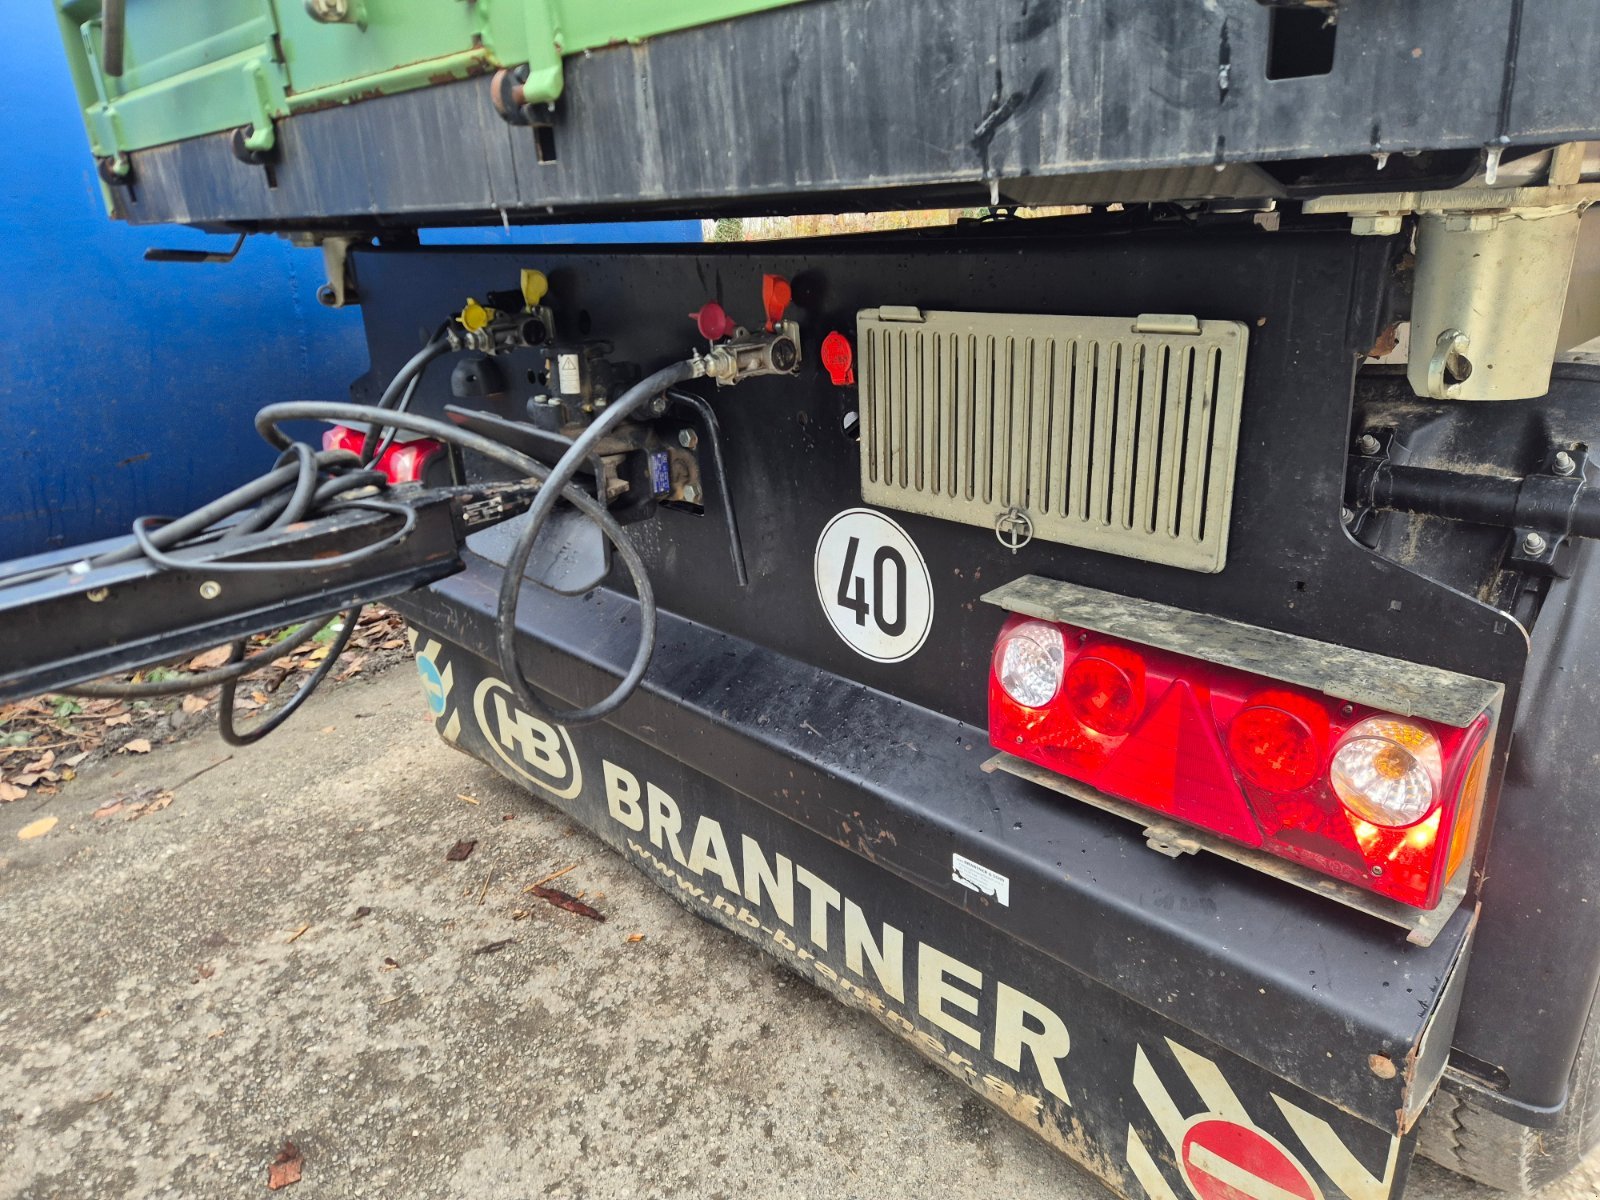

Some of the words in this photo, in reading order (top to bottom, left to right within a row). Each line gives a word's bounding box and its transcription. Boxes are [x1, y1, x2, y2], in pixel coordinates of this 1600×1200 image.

[837, 536, 907, 637] 40
[493, 692, 567, 779] HB
[602, 758, 1072, 1108] BRANTNER
